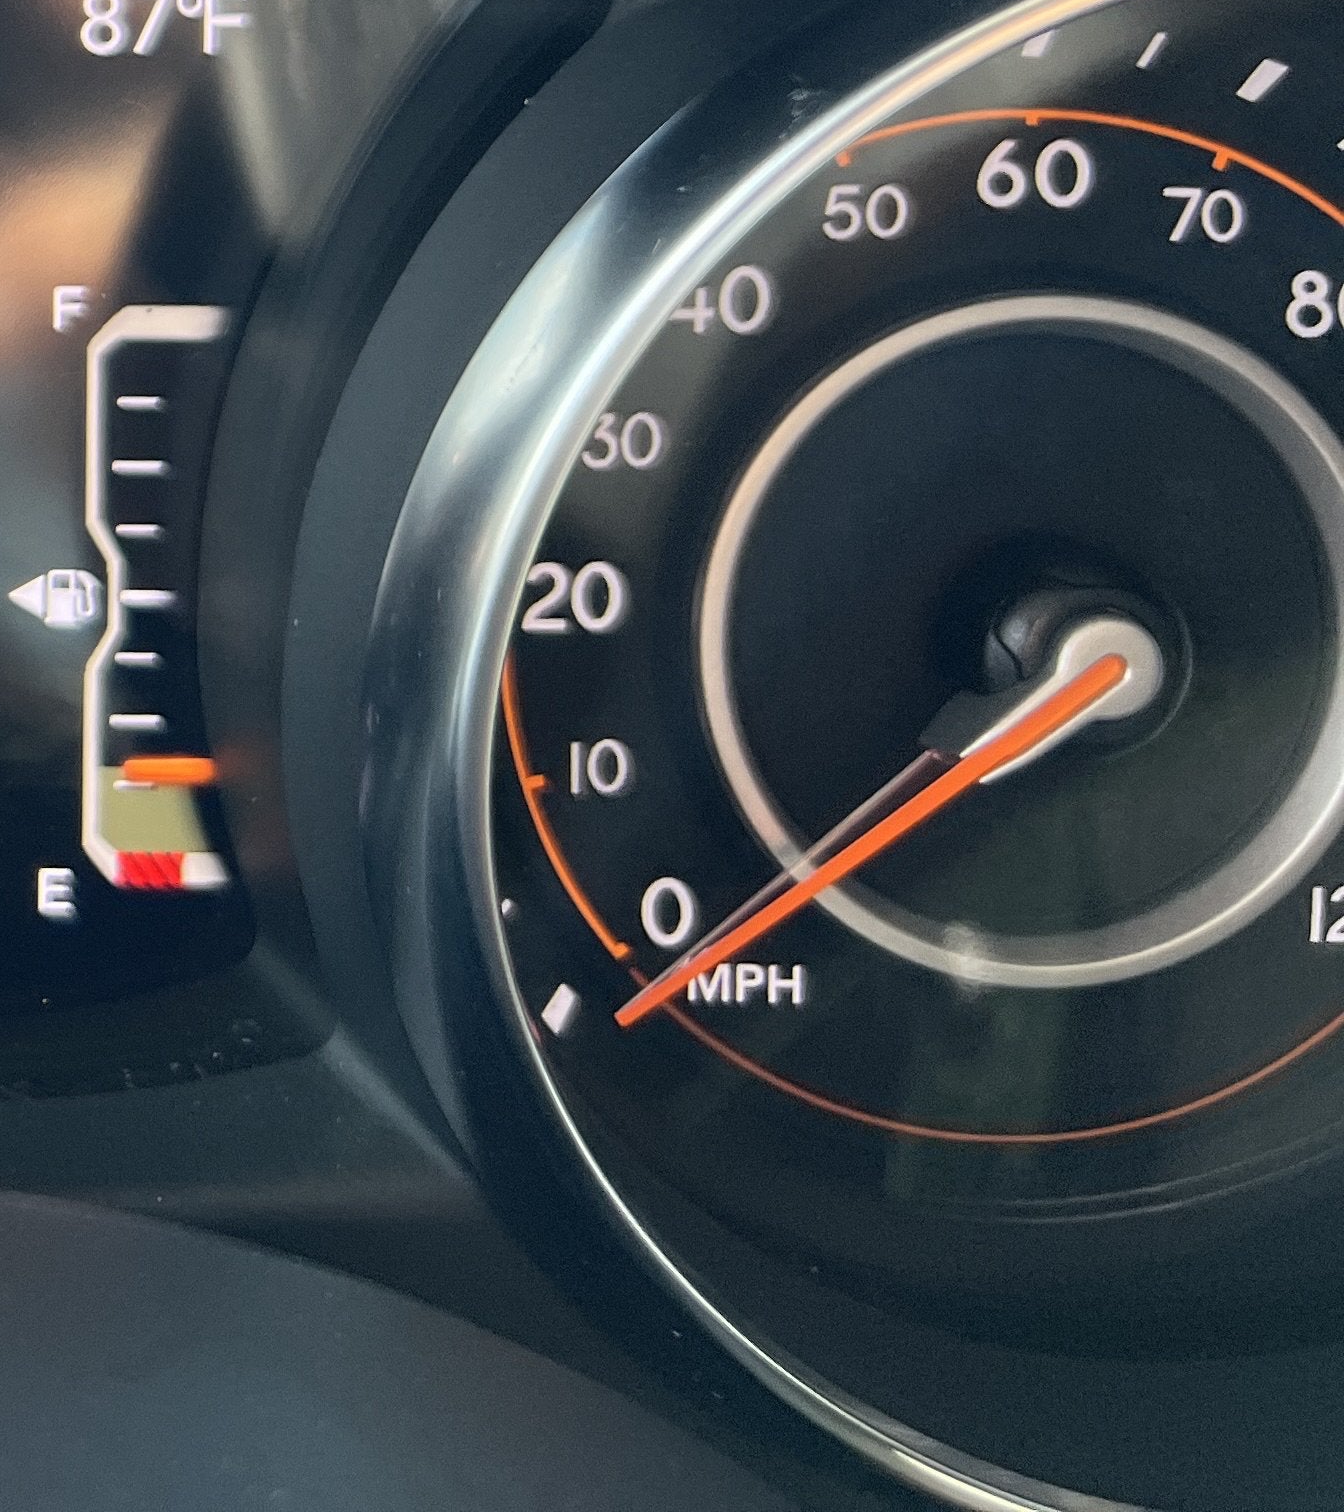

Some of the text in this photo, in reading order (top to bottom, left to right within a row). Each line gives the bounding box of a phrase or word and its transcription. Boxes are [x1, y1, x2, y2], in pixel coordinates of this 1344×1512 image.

[977, 140, 1092, 207] 60
[823, 184, 908, 240] 50
[1163, 187, 1243, 242] 70
[53, 286, 87, 331] F
[1286, 270, 1344, 338] 8
[580, 411, 663, 470] 30
[520, 561, 626, 633] 20
[571, 739, 629, 794] 10
[38, 868, 74, 917] E
[640, 876, 694, 947] 0
[687, 963, 804, 1005] MPH
